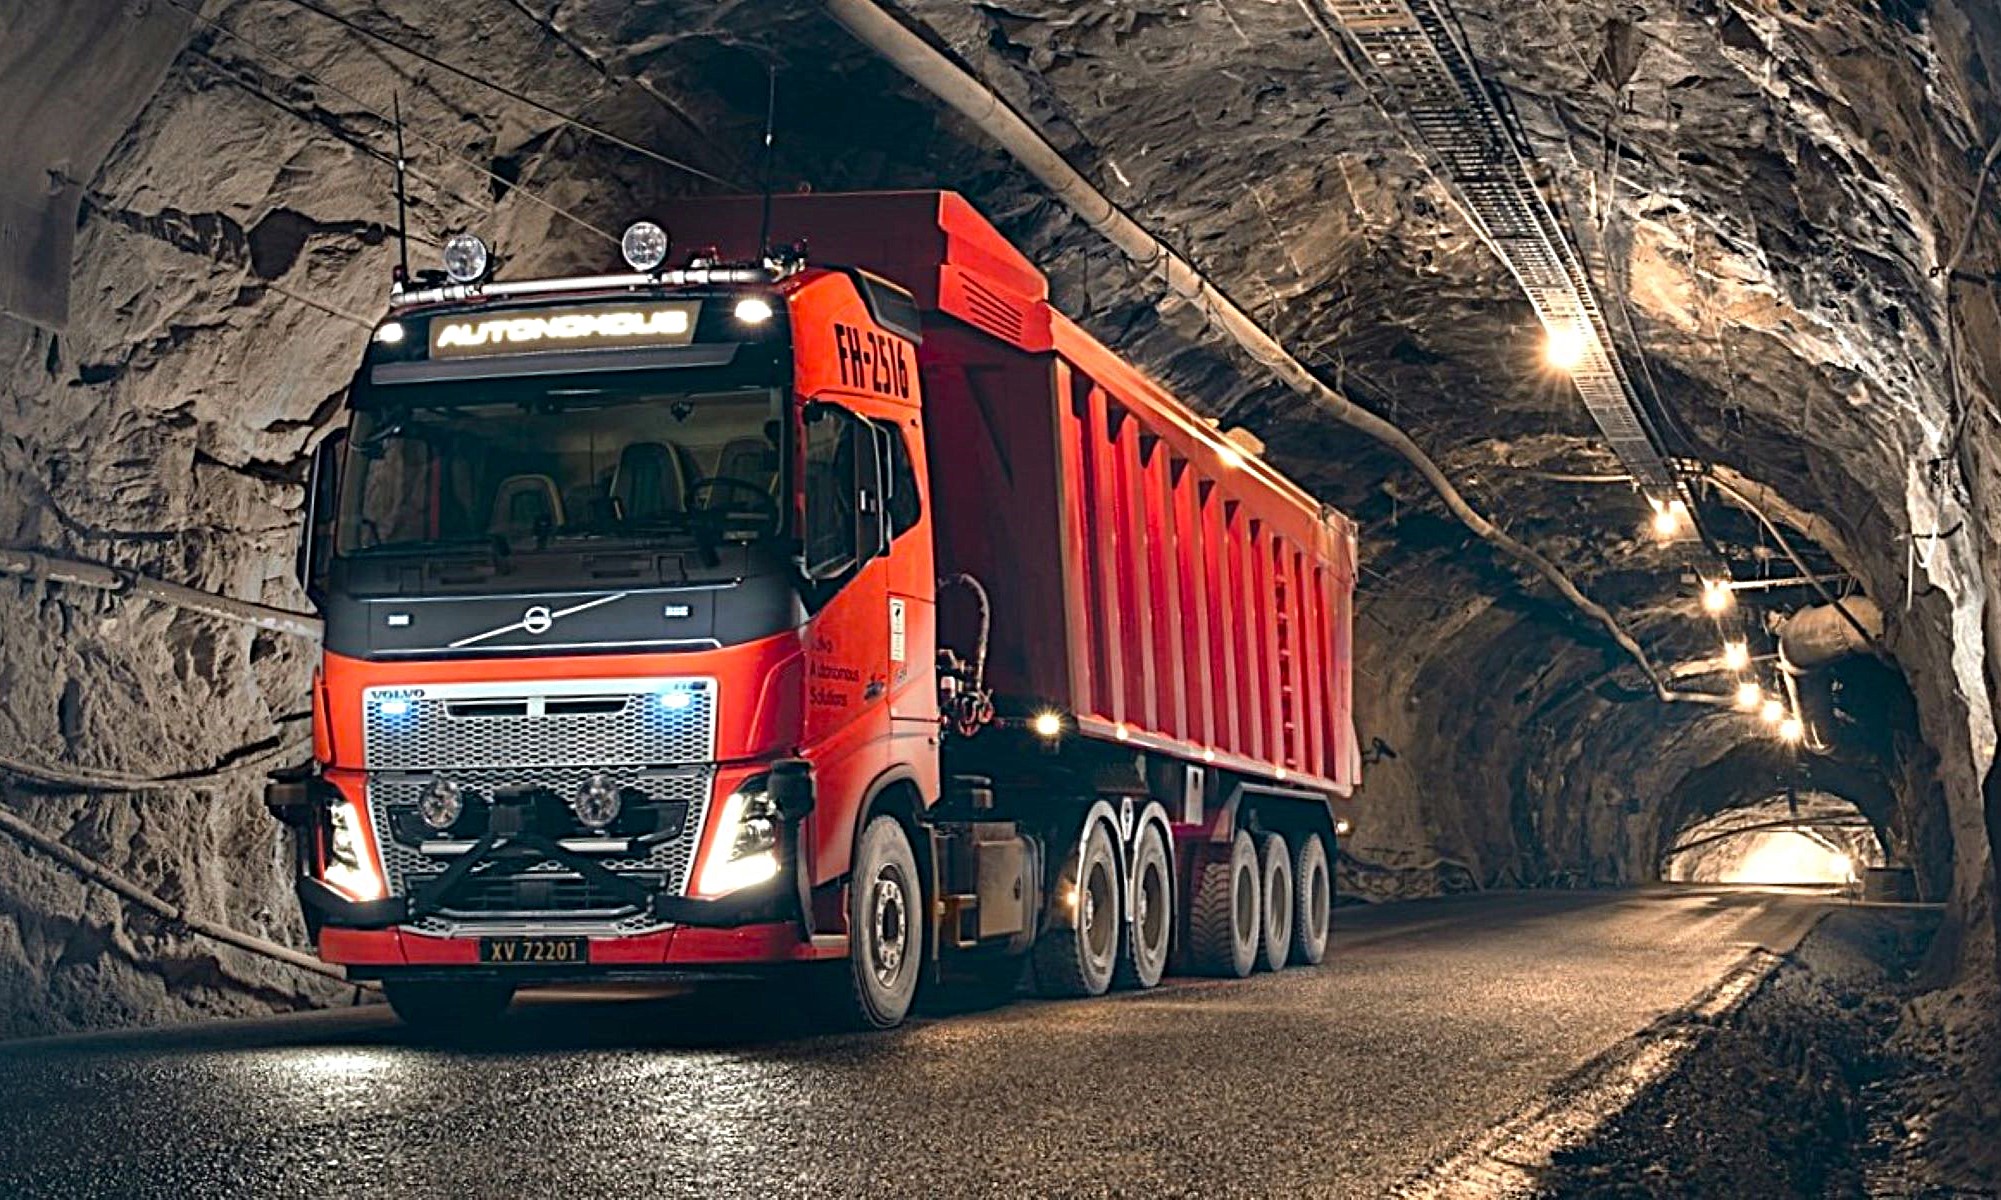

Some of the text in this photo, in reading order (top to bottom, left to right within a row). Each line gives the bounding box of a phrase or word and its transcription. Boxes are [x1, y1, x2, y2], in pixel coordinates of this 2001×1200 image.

[436, 311, 687, 348] AUTONOMOUS
[834, 323, 909, 399] FH-2516
[371, 688, 425, 699] VOLVO
[491, 942, 577, 960] XV 72201
